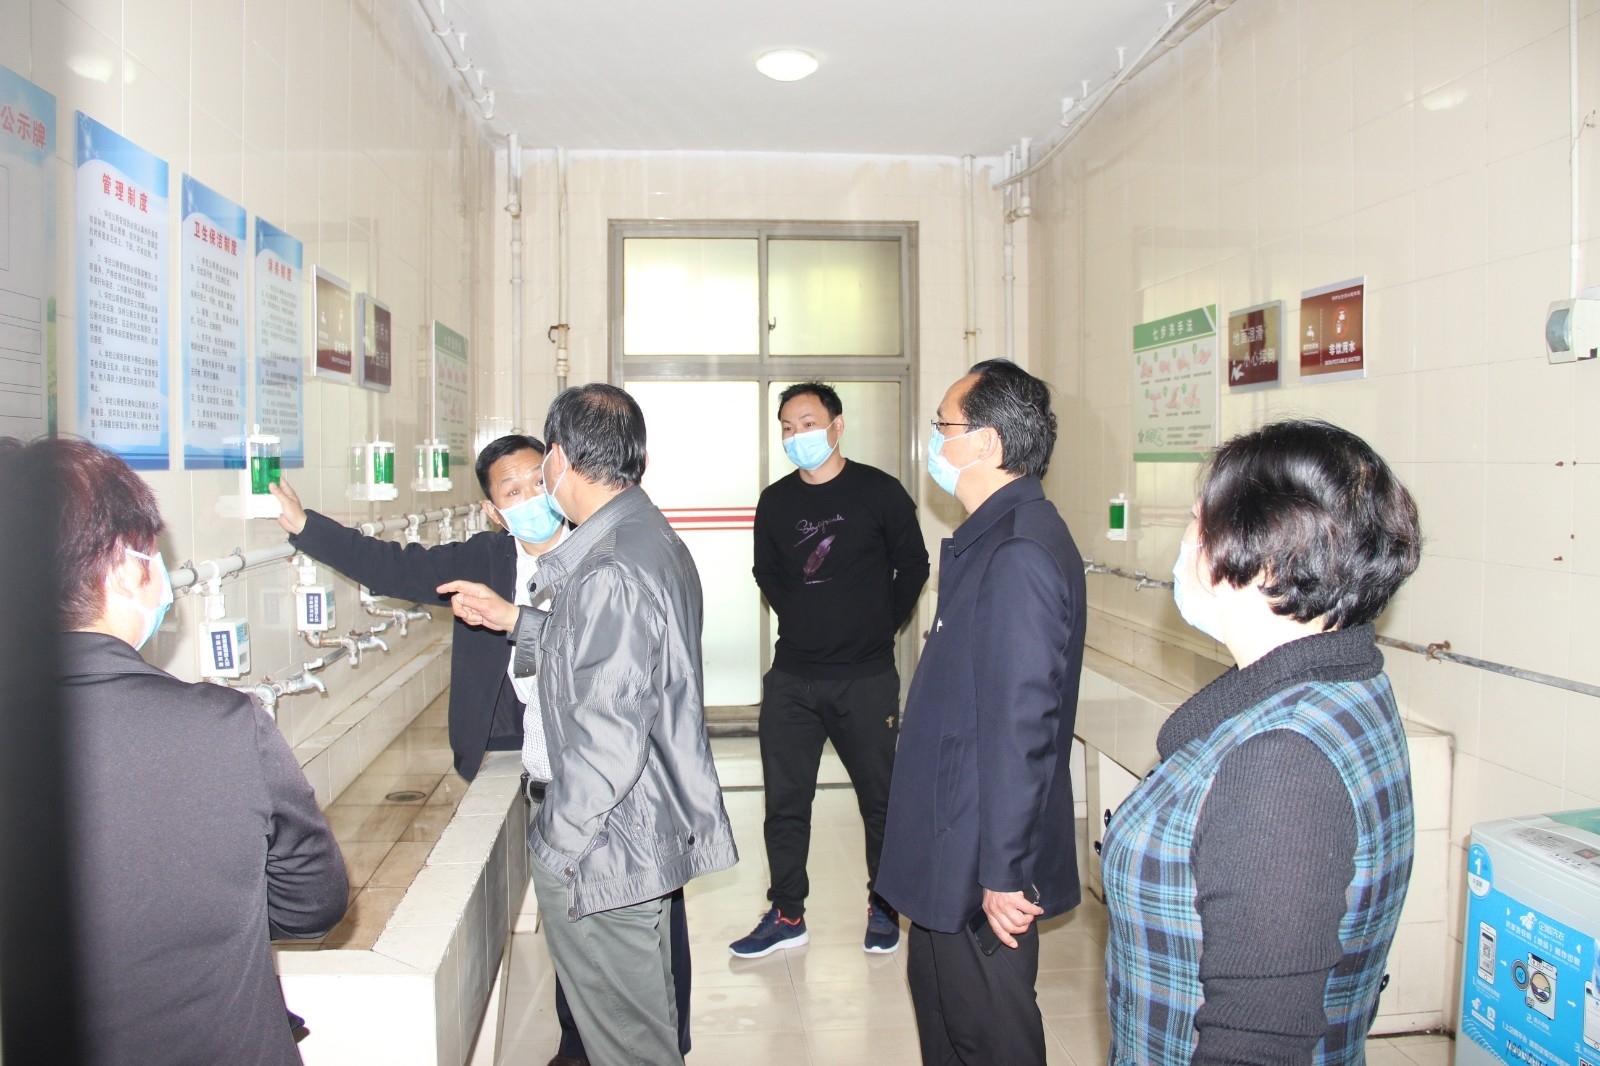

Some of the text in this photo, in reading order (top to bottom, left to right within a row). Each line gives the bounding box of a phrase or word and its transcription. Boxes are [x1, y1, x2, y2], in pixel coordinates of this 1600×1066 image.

[0, 104, 46, 149] 公示牌
[102, 172, 148, 213] 管理制度
[194, 221, 237, 256] 卫生保洁制度
[1152, 318, 1193, 341] 七步洗手法
[1328, 340, 1356, 356] 非饮用水
[1474, 857, 1482, 875] 1
